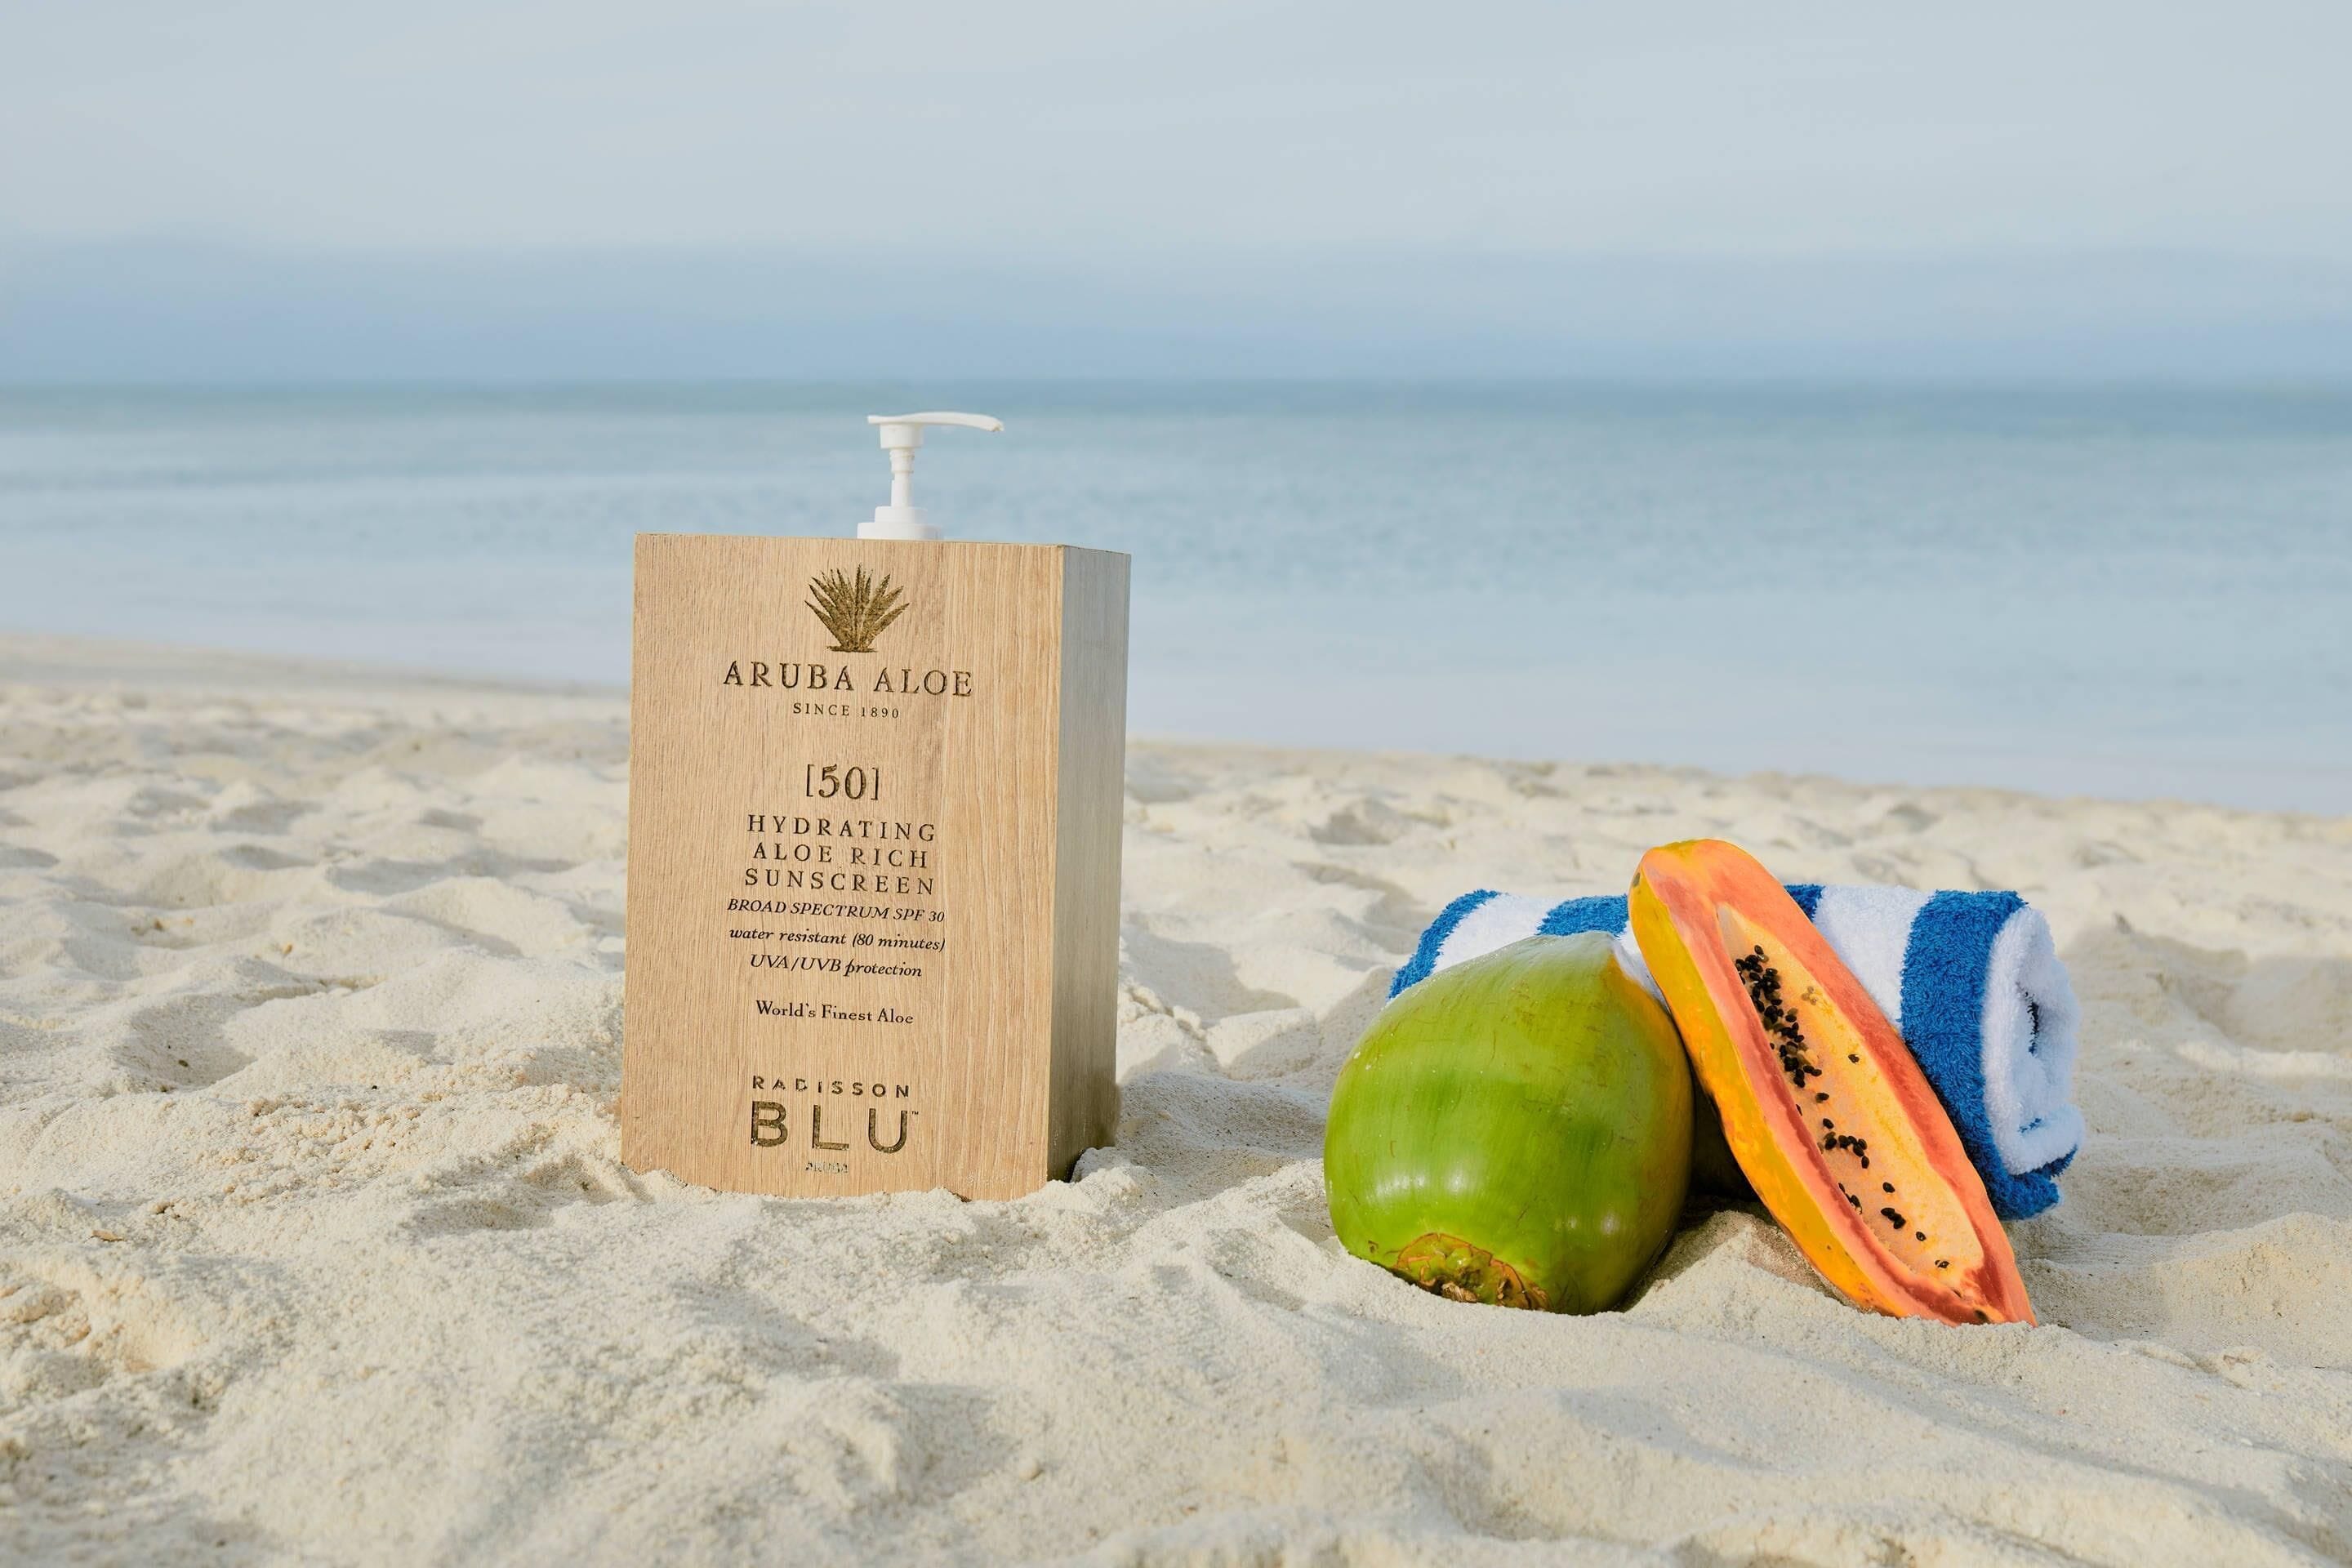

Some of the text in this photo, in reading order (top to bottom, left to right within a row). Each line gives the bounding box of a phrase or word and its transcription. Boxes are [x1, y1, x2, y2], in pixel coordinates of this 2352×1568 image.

[723, 660, 972, 697] ARUBA ALOE
[793, 702, 899, 719] SINCE 1890
[806, 764, 880, 801] [50]
[747, 814, 935, 842] HYDRATING
[753, 842, 927, 868] ALOE RICH
[745, 868, 933, 895] SUNSCREEN
[727, 898, 945, 923] BROAD SPECTRUM SPF 30
[729, 929, 946, 952] water resistant (80 minutes)
[750, 954, 922, 978] UVA/UVB protection
[755, 1000, 914, 1023] World's Finest Aloe
[752, 1075, 910, 1098] RADISSON
